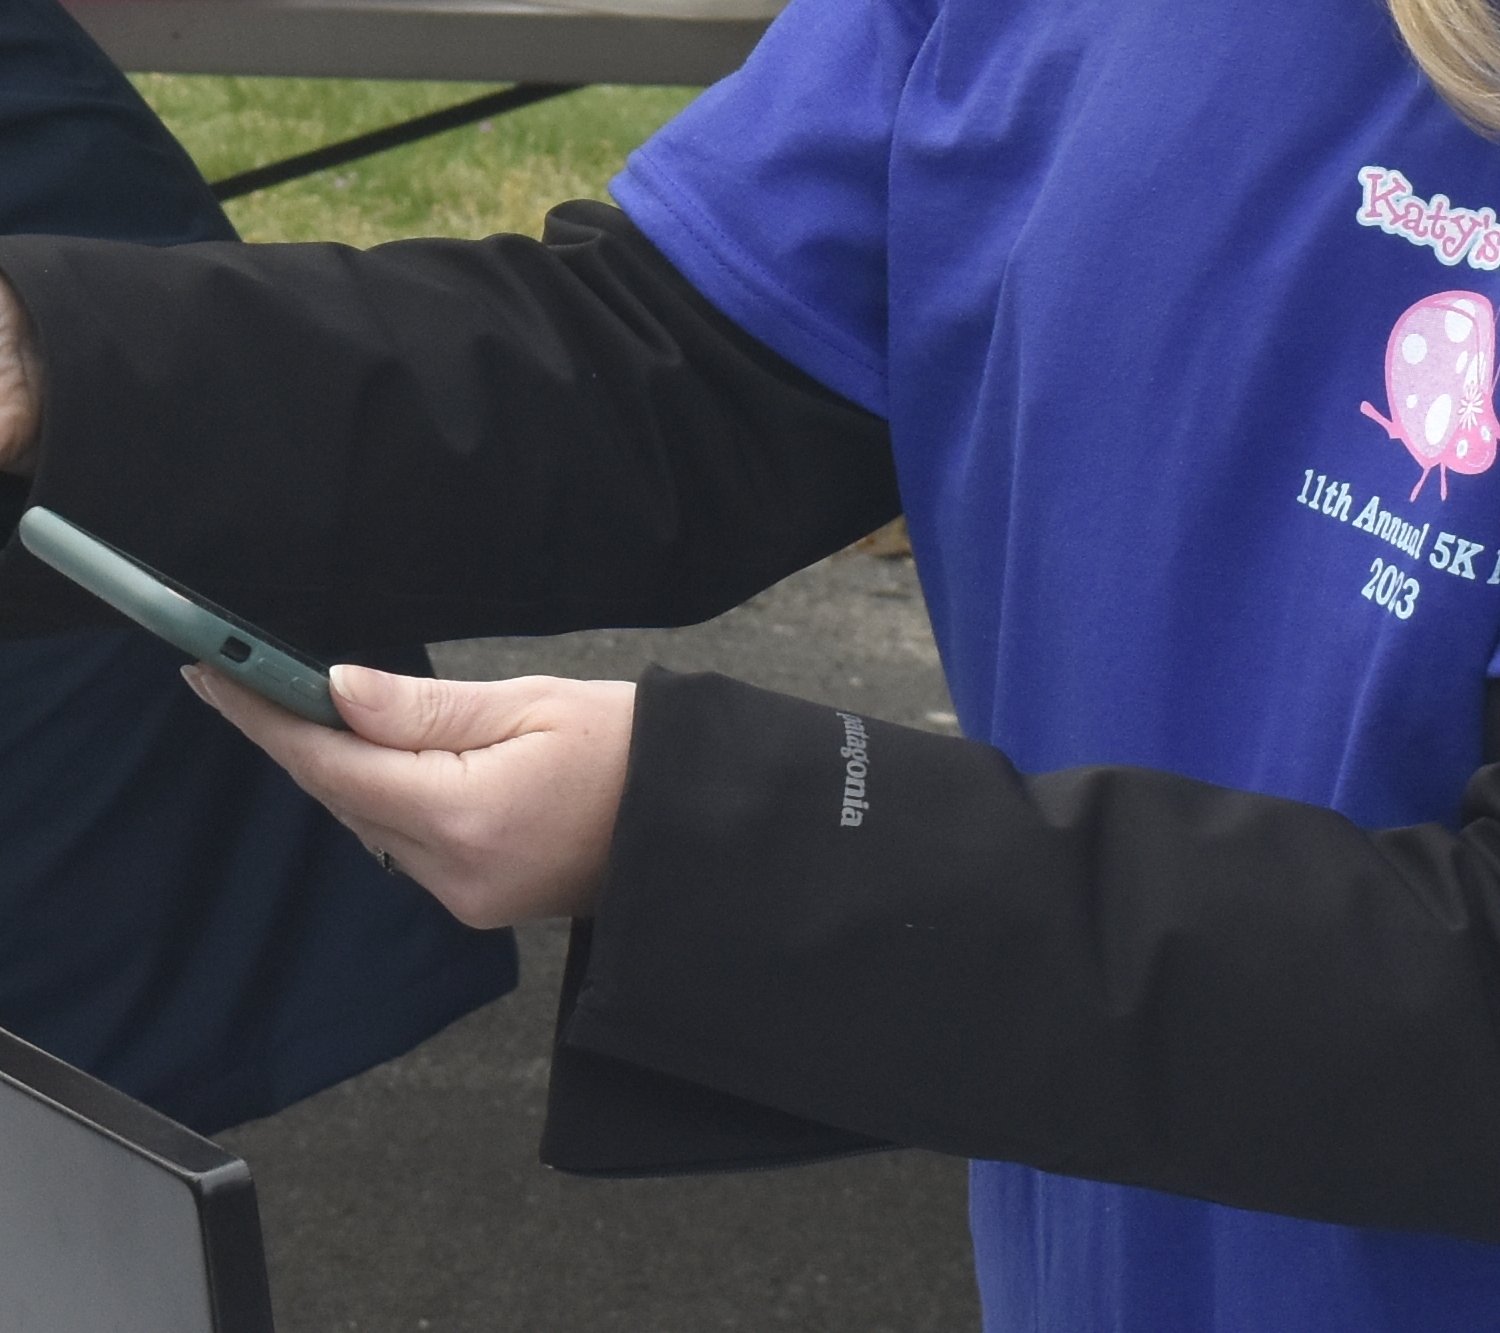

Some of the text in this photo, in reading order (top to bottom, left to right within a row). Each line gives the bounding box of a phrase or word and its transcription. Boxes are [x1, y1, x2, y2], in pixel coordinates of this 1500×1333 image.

[1296, 469, 1352, 522] 11th
[1352, 495, 1431, 560] Annual
[1429, 532, 1485, 580] 5K
